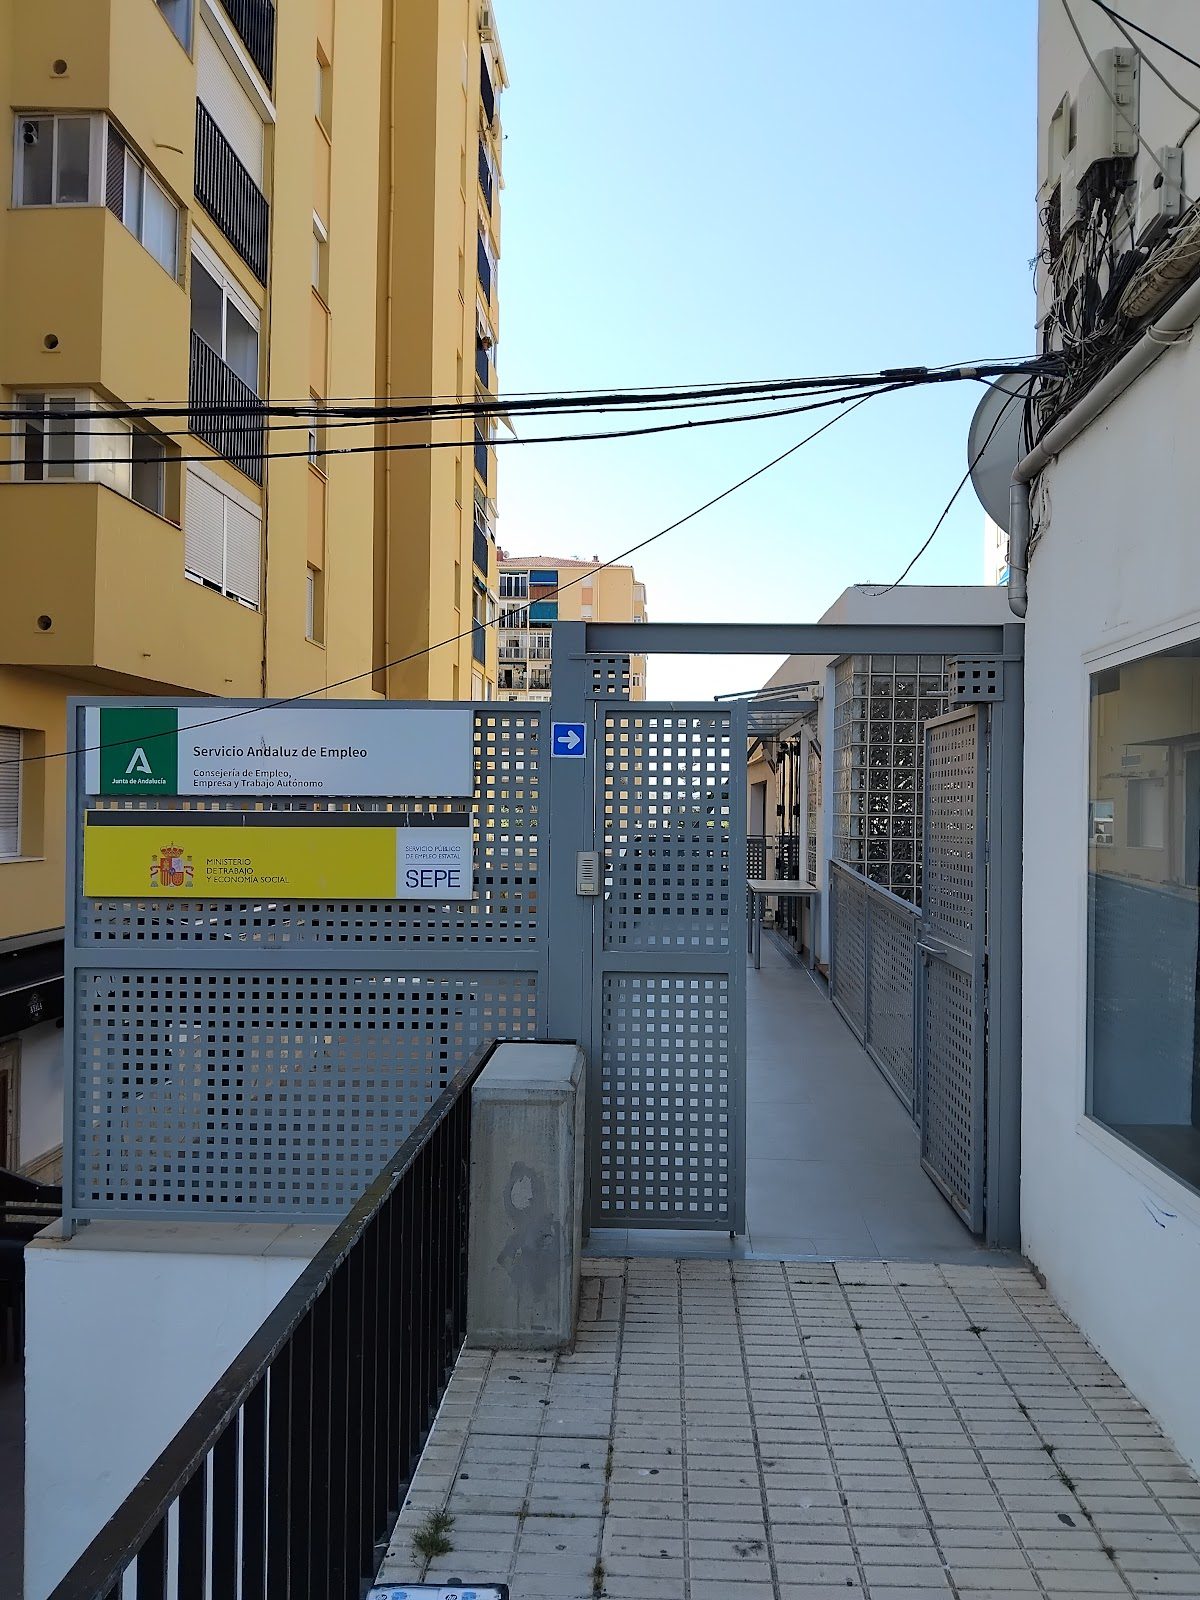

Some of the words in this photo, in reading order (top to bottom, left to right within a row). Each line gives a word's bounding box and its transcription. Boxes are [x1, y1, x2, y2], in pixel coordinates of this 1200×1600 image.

[193, 745, 244, 757] Servicio
[246, 745, 298, 757] Andaluz
[301, 746, 317, 757] de
[320, 746, 367, 759] Empleo
[193, 768, 240, 778] Consejería
[242, 769, 254, 777] de
[255, 769, 292, 778] Empleo,
[193, 779, 232, 788] Empresa
[241, 779, 275, 788] Trabajo
[276, 778, 324, 788] Autónomo
[206, 858, 252, 866] MINISTERIO
[219, 867, 254, 875] TRABAJO
[213, 875, 259, 883] ECONOMÍA
[260, 876, 290, 884] SOCIAL
[405, 869, 461, 888] SEPE
